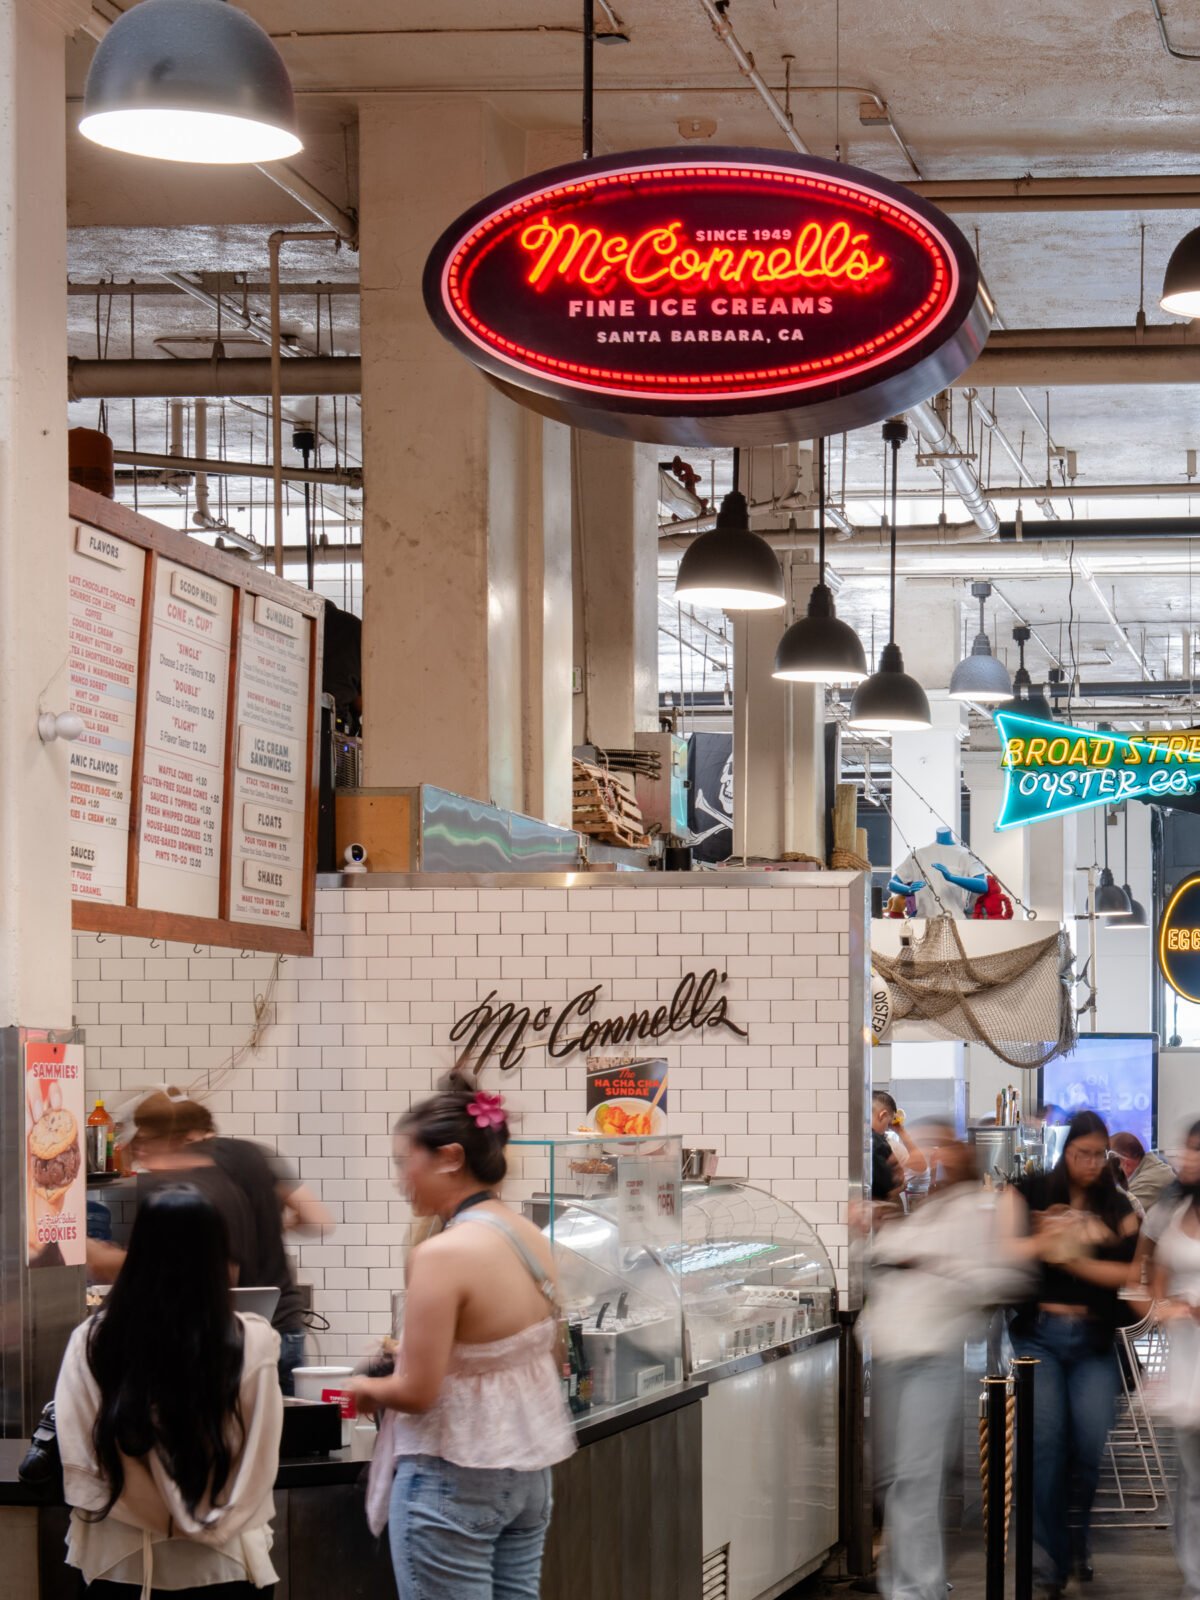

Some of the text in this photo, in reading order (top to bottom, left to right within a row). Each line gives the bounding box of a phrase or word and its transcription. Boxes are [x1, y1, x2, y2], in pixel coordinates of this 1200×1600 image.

[696, 228, 792, 242] SINCE 1949
[520, 215, 886, 285] McConnell's
[568, 297, 834, 318] FINE ICE CREAMS
[597, 328, 804, 344] SANTA BARBARA, CA
[89, 536, 119, 559] FLAVORS
[180, 579, 217, 607] SCOOP MENU
[167, 603, 187, 623] CONE
[266, 607, 294, 629] SUNDAES
[254, 738, 289, 758] ICE CREAM
[1002, 737, 1115, 767] BROAD
[70, 753, 119, 776] ANIC FLAVORS
[250, 751, 292, 773] SANDWICHES
[158, 764, 177, 778] WAFFLE
[178, 770, 193, 783] CONES
[1018, 768, 1141, 809] OYSTER
[258, 813, 282, 829] FLOATS
[71, 846, 95, 861] SAUCES
[258, 870, 282, 887] SHAKES
[449, 968, 748, 1076] McConnell's
[32, 1063, 79, 1080] SAMMIES!
[619, 1068, 636, 1079] The
[594, 1079, 610, 1087] HA
[612, 1079, 635, 1087] CHA
[605, 1087, 649, 1096] SUNDAE
[38, 1226, 77, 1243] COOKIES
